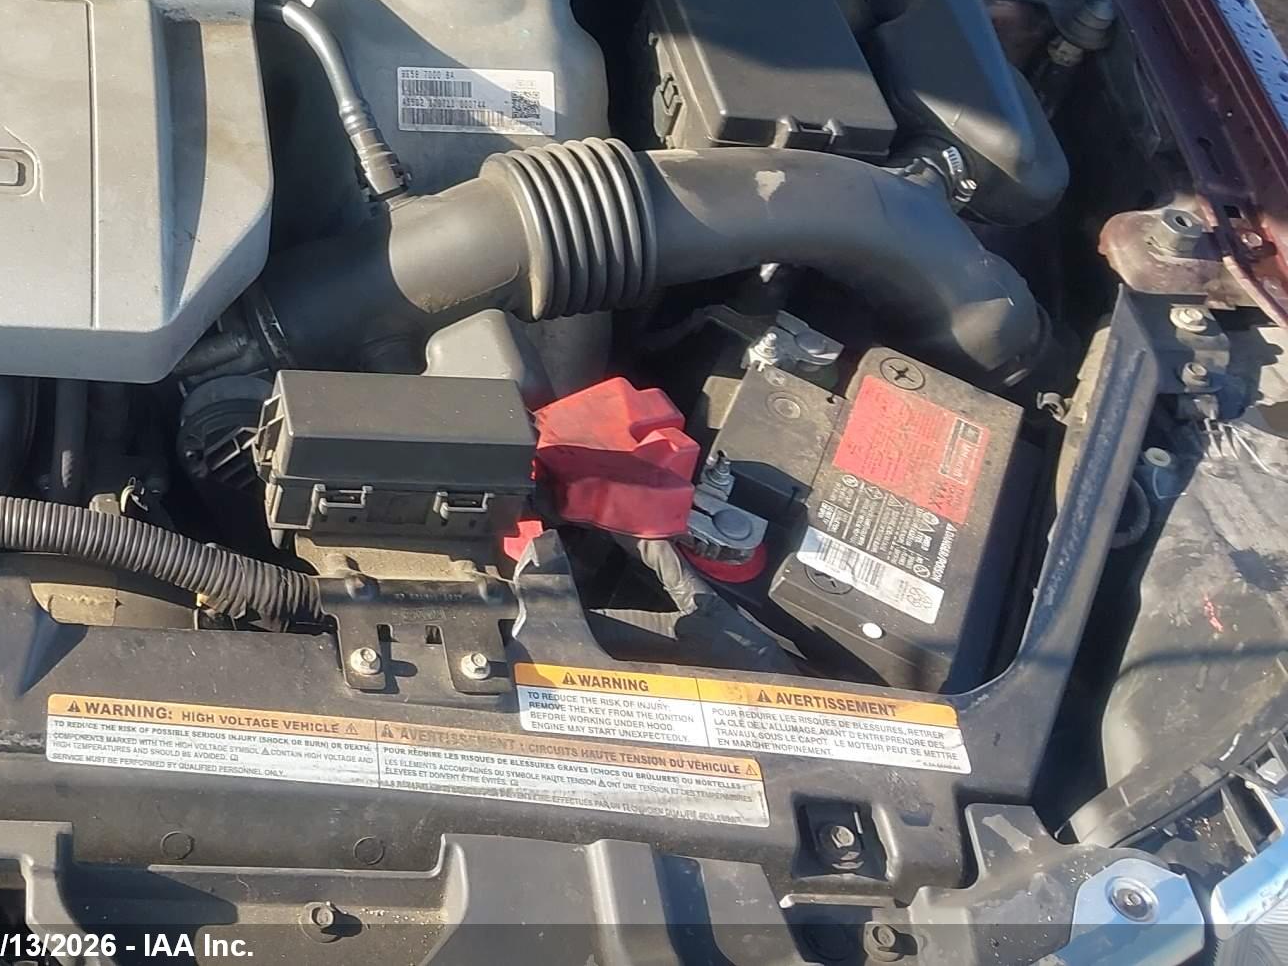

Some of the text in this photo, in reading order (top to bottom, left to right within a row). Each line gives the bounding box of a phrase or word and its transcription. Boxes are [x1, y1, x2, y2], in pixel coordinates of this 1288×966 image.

[577, 673, 649, 692] WARNING
[528, 691, 540, 700] TO
[542, 692, 578, 703] REDUCE
[580, 696, 597, 705] THE
[600, 697, 620, 707] RISK
[623, 700, 634, 708] OF
[775, 692, 897, 717] AVERTISSEMENT
[84, 701, 340, 734] WARNING: HIGH VOLTAGE VEHICLE
[529, 701, 694, 723] REMOVE THE KEY FROM THE IGNITION
[530, 711, 567, 722] BEFORE
[569, 714, 611, 726] WORKING
[614, 718, 644, 728] UNDER
[712, 707, 737, 716] POUR
[779, 713, 797, 723] LES
[798, 715, 836, 727] RISQUES
[839, 720, 852, 728] DE
[907, 729, 945, 740] RETIRER
[67, 721, 98, 730] REDUCE
[100, 723, 116, 731] THE
[118, 724, 136, 733] RISK
[139, 726, 150, 734] OF
[152, 727, 190, 737] POSSIBLE
[191, 731, 226, 740] SERIOUS
[228, 734, 256, 743] INJURY
[291, 738, 303, 746] OR
[331, 742, 342, 750] OR
[532, 721, 564, 732] ENGINE
[567, 724, 586, 734] MAY
[588, 726, 616, 736] START
[713, 718, 725, 726] LA
[747, 721, 760, 729] DE
[819, 728, 846, 738] AVANT
[928, 740, 945, 749] DES
[52, 741, 72, 749] HIGH
[73, 742, 131, 754] TEMPERATURES
[133, 746, 149, 754] AND
[150, 747, 180, 757] SHOULD
[182, 750, 192, 758] BE
[53, 732, 374, 764] COMPONENTS MARKED WITH THE HIGH VOLTAGE SYMBOL CONTAIN HIGH VOLTAGE AND
[400, 728, 515, 750] AVERTISSEMENT
[528, 743, 578, 758] CIRCUITS
[581, 748, 617, 761] HAUTE
[620, 752, 667, 767] TENSION
[669, 758, 685, 768] DU
[716, 728, 756, 739] TRAVAUX
[758, 731, 784, 741] SOUS
[786, 734, 796, 743] LE
[834, 739, 846, 747] LE
[848, 740, 885, 753] MOTEUR
[886, 745, 908, 755] PEUT
[910, 748, 922, 757] SE
[923, 750, 959, 761] METTRE
[718, 738, 730, 746] EN
[52, 752, 85, 762] SERVICE
[86, 754, 105, 763] MUST
[107, 756, 118, 764] BE
[119, 757, 166, 768] PERFORMED
[167, 761, 177, 769] BY
[178, 761, 218, 772] QUALIFIED
[218, 765, 263, 775] PERSONNEL
